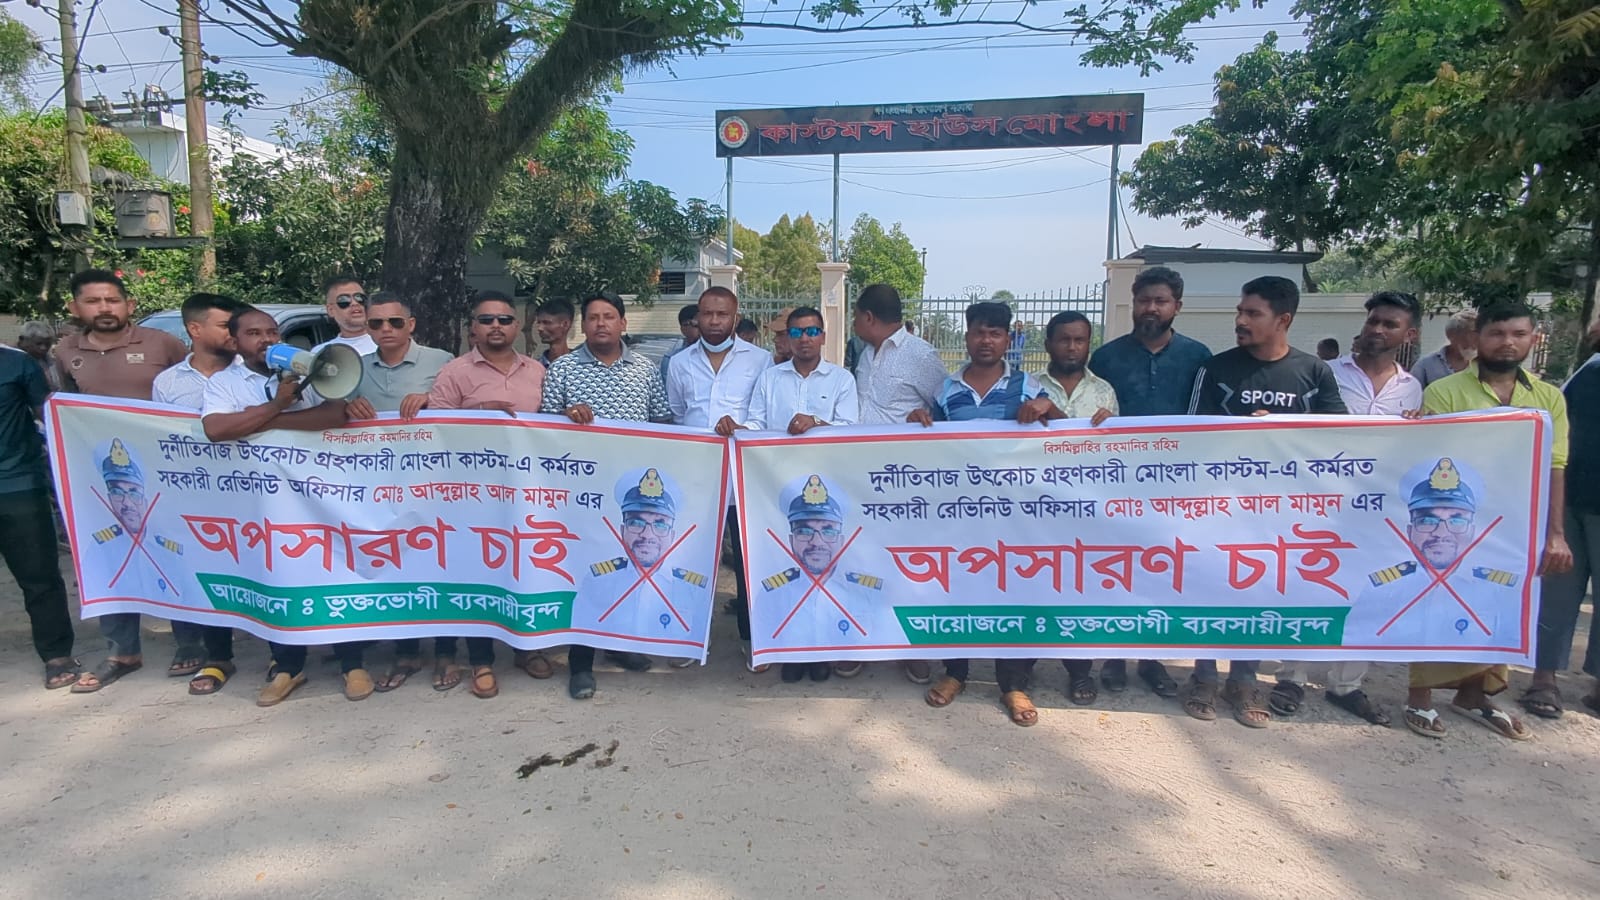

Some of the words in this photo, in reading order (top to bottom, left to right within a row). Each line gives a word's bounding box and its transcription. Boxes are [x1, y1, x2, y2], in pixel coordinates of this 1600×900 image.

[758, 117, 898, 144] কাস্টমস
[904, 112, 1002, 142] হাউস
[1241, 390, 1297, 407] SPORT
[158, 433, 231, 461] দুর্নীতিবাজ
[236, 440, 311, 465] উৎকোচ
[314, 447, 396, 473] গ্রহণকারী
[400, 450, 451, 471] মোংলা
[456, 448, 531, 473] কাস্টম-এ
[538, 452, 597, 476] কর্মরত
[322, 431, 375, 444] বিসমিল্লাহির
[379, 430, 411, 442] রহমানির
[414, 428, 432, 441] রহিম
[1043, 440, 1101, 455] বিসমিল্লাহির
[1104, 438, 1148, 452] রহমানির
[1152, 436, 1179, 451] রহিম
[157, 466, 211, 492] সহকারী
[217, 469, 281, 497] রেভিনিউ
[287, 475, 367, 503] অফিসার
[373, 483, 404, 504] মোঃ
[408, 481, 481, 504] আব্দুল্লাহ
[485, 482, 517, 505] আল
[522, 485, 571, 510] মামুন
[576, 491, 604, 510] এর
[868, 463, 960, 493] দুর্নীতিবাজ
[965, 463, 1038, 488] উৎকোচ
[1041, 457, 1128, 488] গ্রহণকারী
[1135, 460, 1198, 483] মোংলা
[1203, 455, 1298, 481] কাস্টম-এ
[1305, 451, 1377, 478] কর্মরত
[861, 496, 930, 521] সহকারী
[936, 495, 1014, 519] রেভিনিউ
[1019, 494, 1098, 520] অফিসার
[1104, 497, 1144, 518] মোঃ
[1149, 495, 1232, 520] আব্দুল্লাহ
[1237, 493, 1282, 515] আল
[1288, 492, 1344, 518] মামুন
[1351, 492, 1386, 512] এর
[181, 514, 457, 573] অপসারণ
[468, 514, 582, 585] চাই
[885, 535, 1201, 594] অপসারণ
[1214, 523, 1359, 600] চাই
[209, 582, 292, 616] আয়োজনে
[322, 586, 441, 618] ভুক্তভোগী
[449, 588, 563, 629] ব্যবসায়ীবৃন্দ
[906, 613, 1026, 635] আয়োজনে
[1055, 609, 1171, 640] ভুক্তভোগী
[1180, 613, 1335, 641] ব্যবসায়ীবৃন্দ
